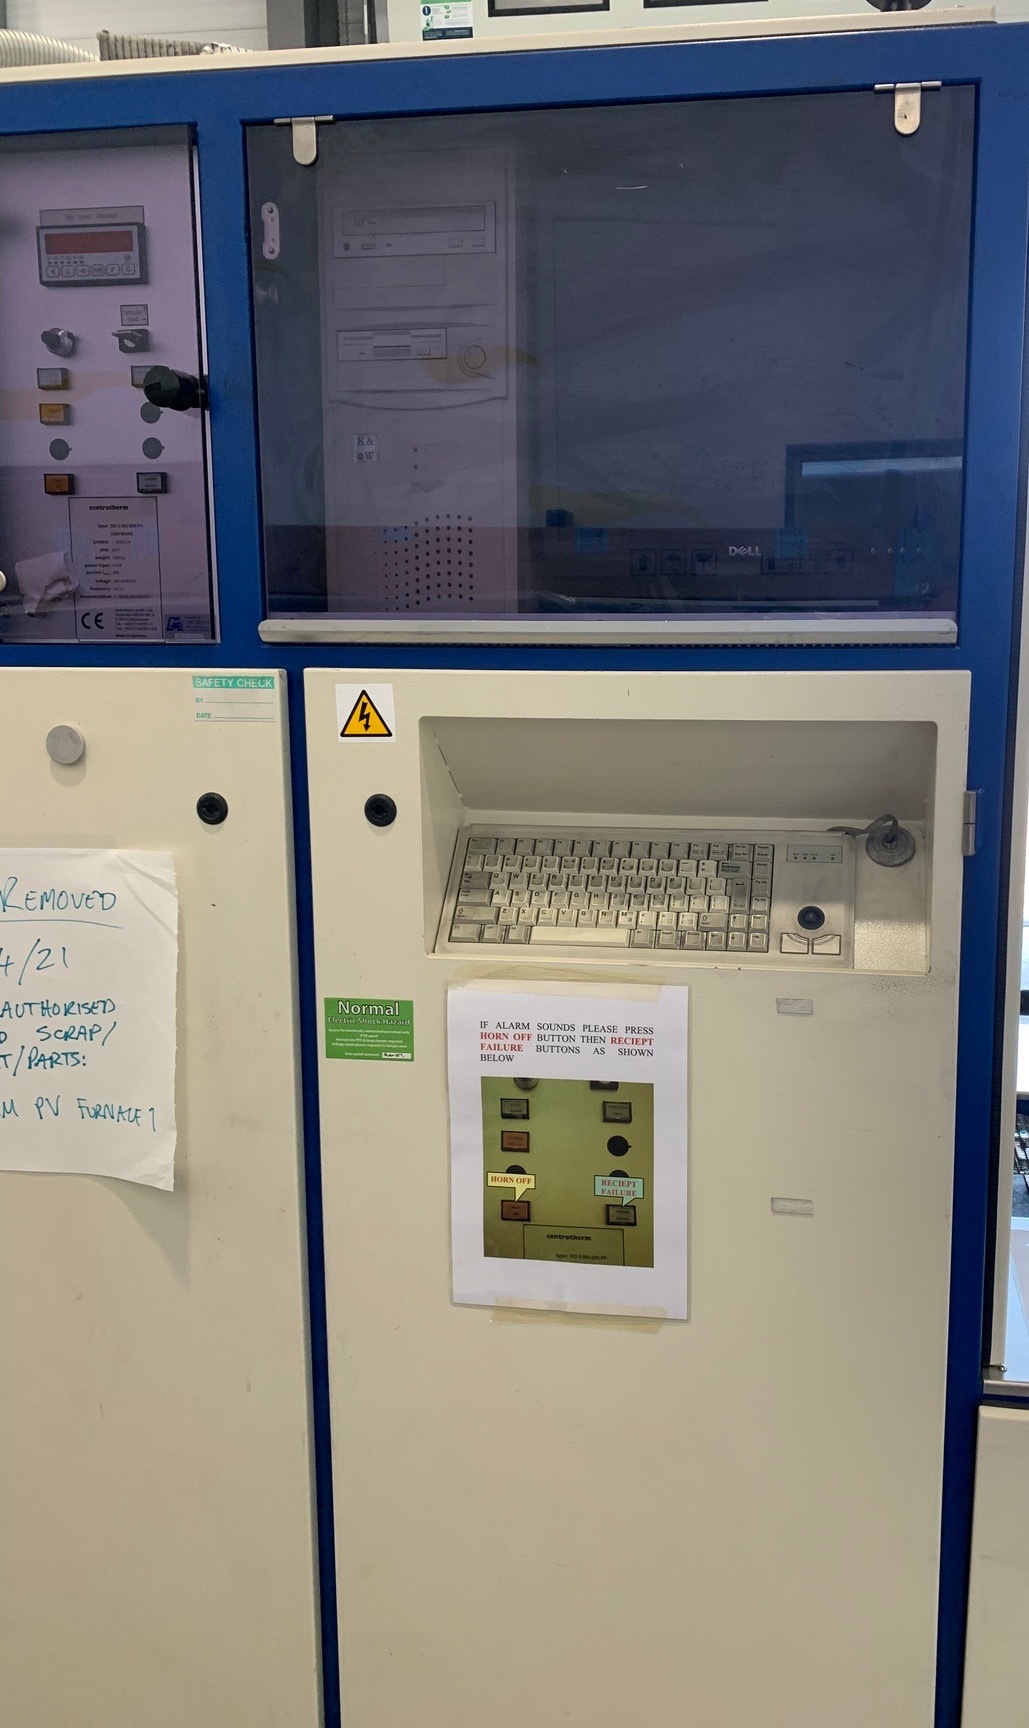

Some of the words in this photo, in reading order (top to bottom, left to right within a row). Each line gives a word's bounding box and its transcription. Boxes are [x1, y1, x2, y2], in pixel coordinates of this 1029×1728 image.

[728, 546, 762, 556] DELL
[195, 678, 234, 688] SAFETY
[236, 678, 273, 688] CHECK
[0, 876, 117, 913] REMOVED
[0, 998, 116, 1019] AUTHORISED
[337, 1001, 399, 1016] Normal
[328, 1016, 355, 1024] Electric
[358, 1017, 381, 1025] Shock
[383, 1018, 410, 1026] Hazard
[36, 1021, 117, 1046] SCRAP/
[480, 1021, 488, 1029] IF
[495, 1022, 530, 1030] ALARM
[536, 1023, 576, 1032] SOUNDS
[582, 1024, 618, 1034] PLEASE
[625, 1026, 654, 1035] PRESS
[480, 1032, 509, 1041] HORN
[513, 1033, 532, 1042] OFF
[536, 1034, 576, 1043] BUTTON
[580, 1035, 606, 1044] THEN
[610, 1037, 654, 1046] RECIEPT
[480, 1043, 523, 1052] FAILURE
[536, 1045, 580, 1054] BUTTONS
[593, 1047, 606, 1056] AS
[618, 1048, 654, 1057] SHOWN
[480, 1054, 515, 1062] BELOW
[34, 1095, 61, 1120] PV
[490, 1175, 515, 1183] HORN
[516, 1176, 532, 1185] OFF
[601, 1179, 637, 1188] RECIEPT
[601, 1188, 638, 1197] FAILURE
[546, 1233, 592, 1241] centrotherm
